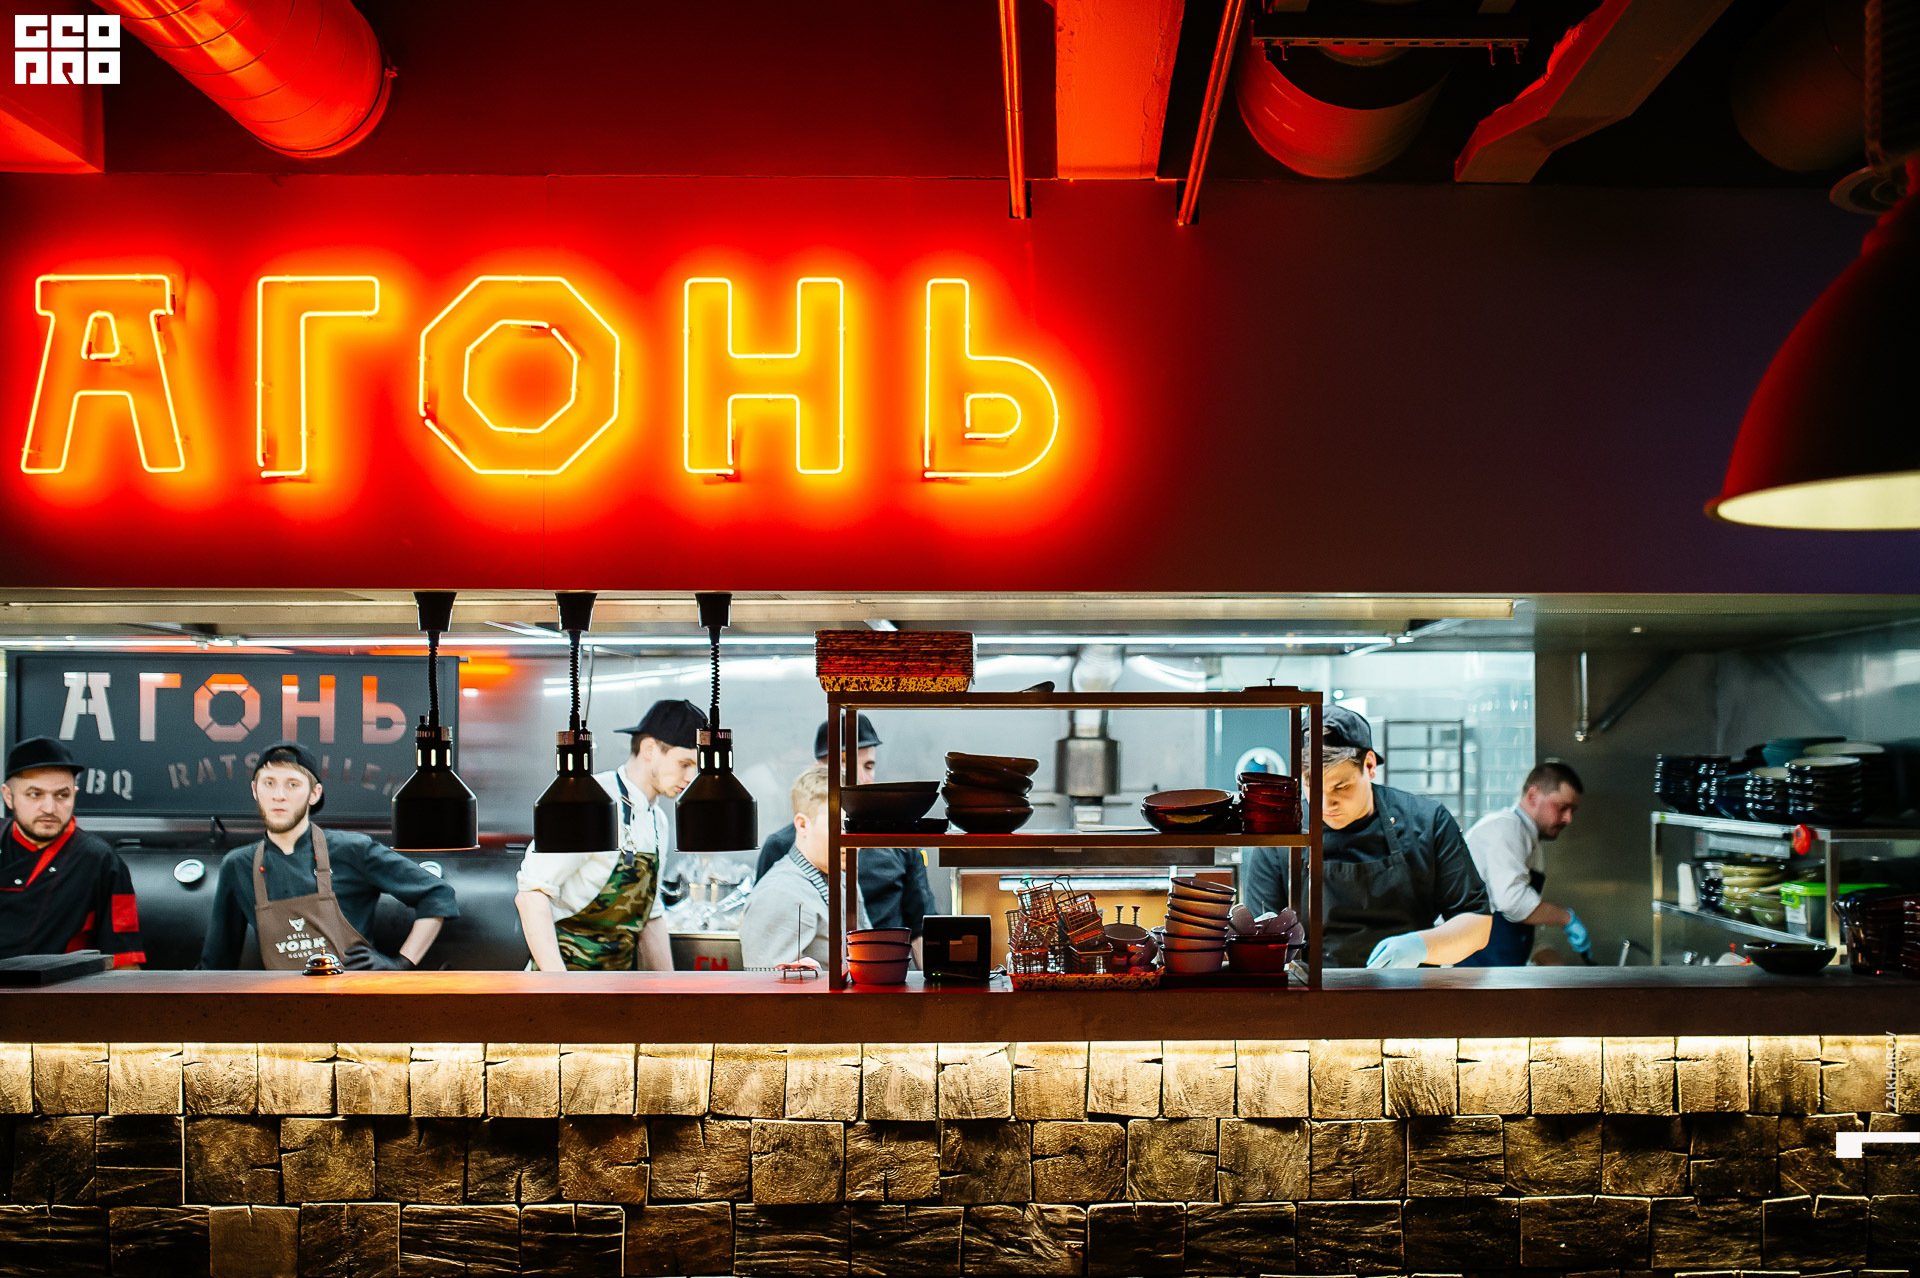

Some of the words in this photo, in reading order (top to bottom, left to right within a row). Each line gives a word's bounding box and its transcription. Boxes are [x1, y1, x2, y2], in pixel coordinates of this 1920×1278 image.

[21, 274, 1060, 479] АГОНЬ
[59, 671, 407, 745] АГОНЬ
[75, 767, 133, 801] BQ
[167, 751, 402, 797] RATSLLE
[275, 936, 327, 954] YORK
